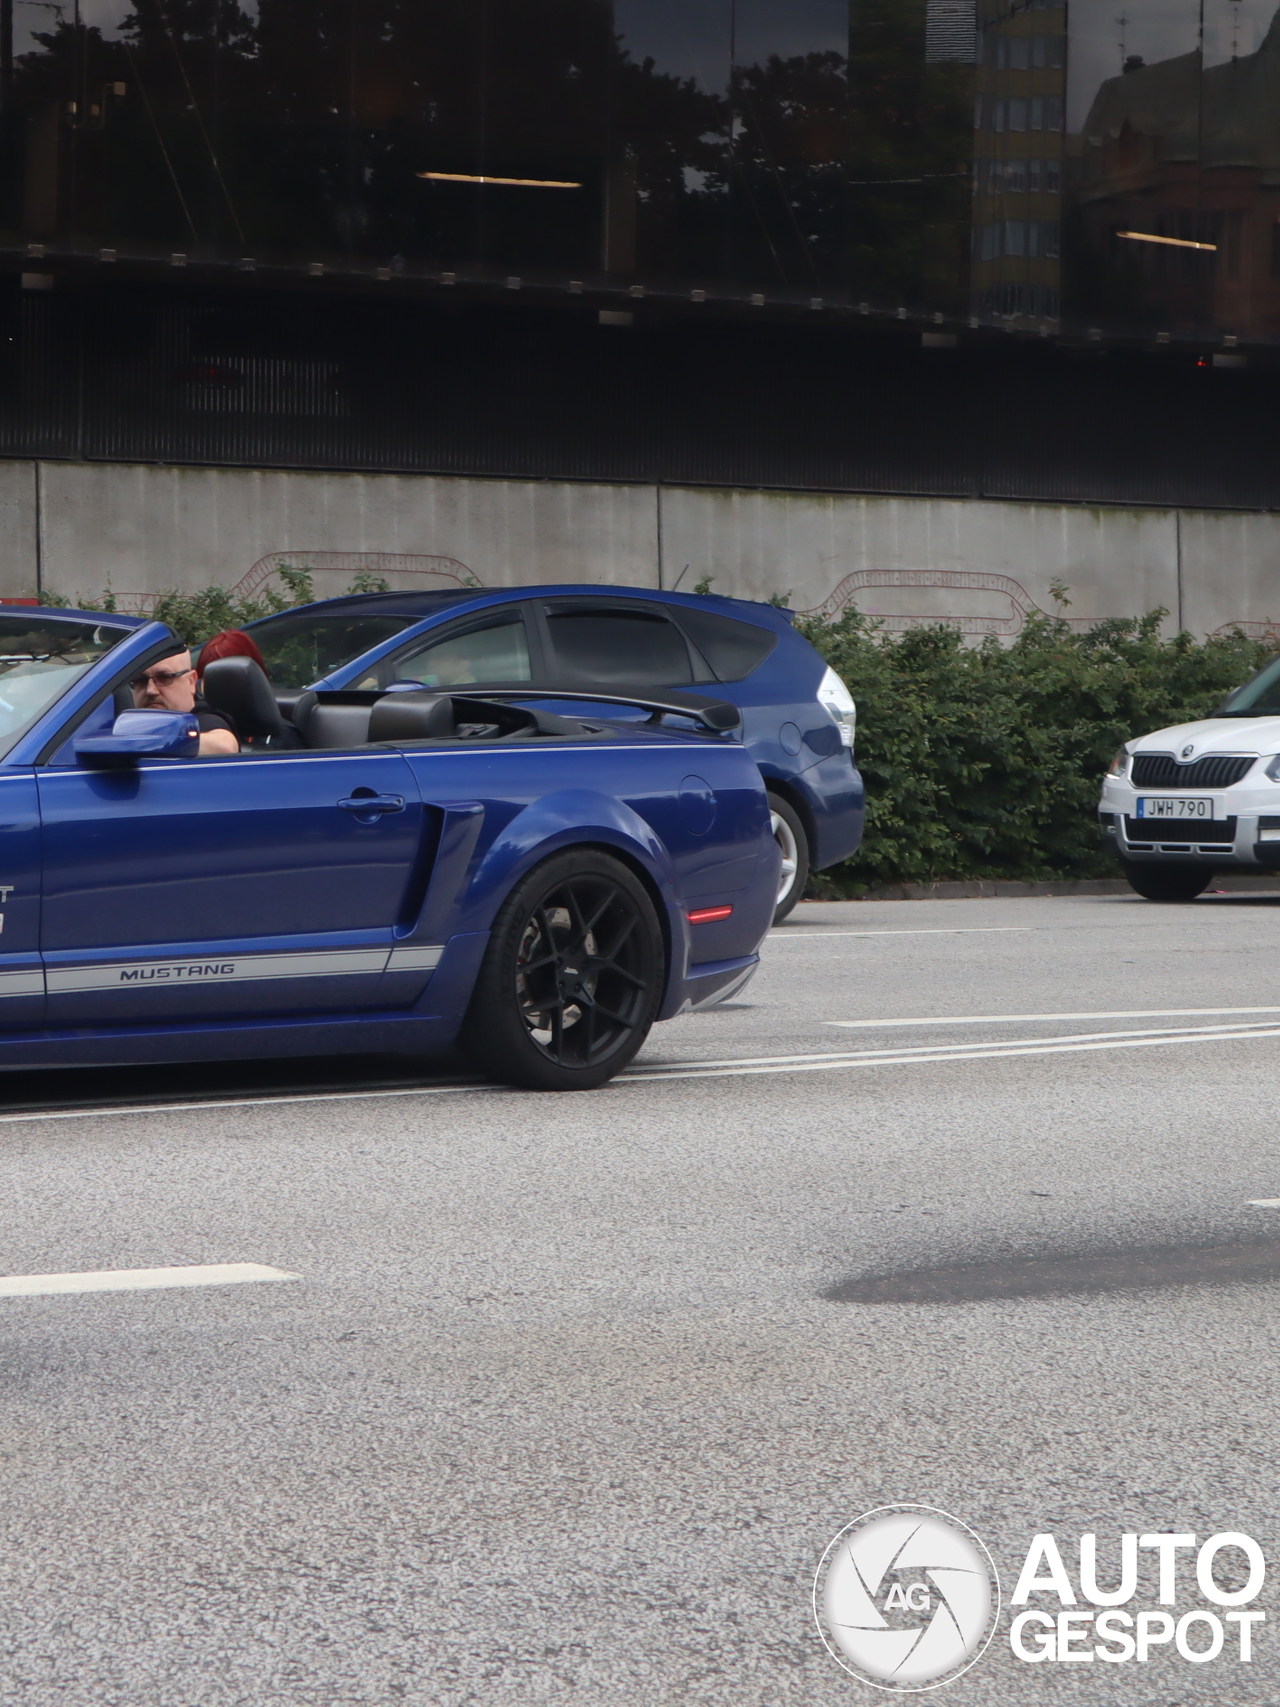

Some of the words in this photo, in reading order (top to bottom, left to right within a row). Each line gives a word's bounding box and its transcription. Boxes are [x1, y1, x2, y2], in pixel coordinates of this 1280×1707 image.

[1149, 800, 1174, 816] JWH
[1178, 801, 1205, 817] 790
[120, 963, 235, 981] MUSTANG
